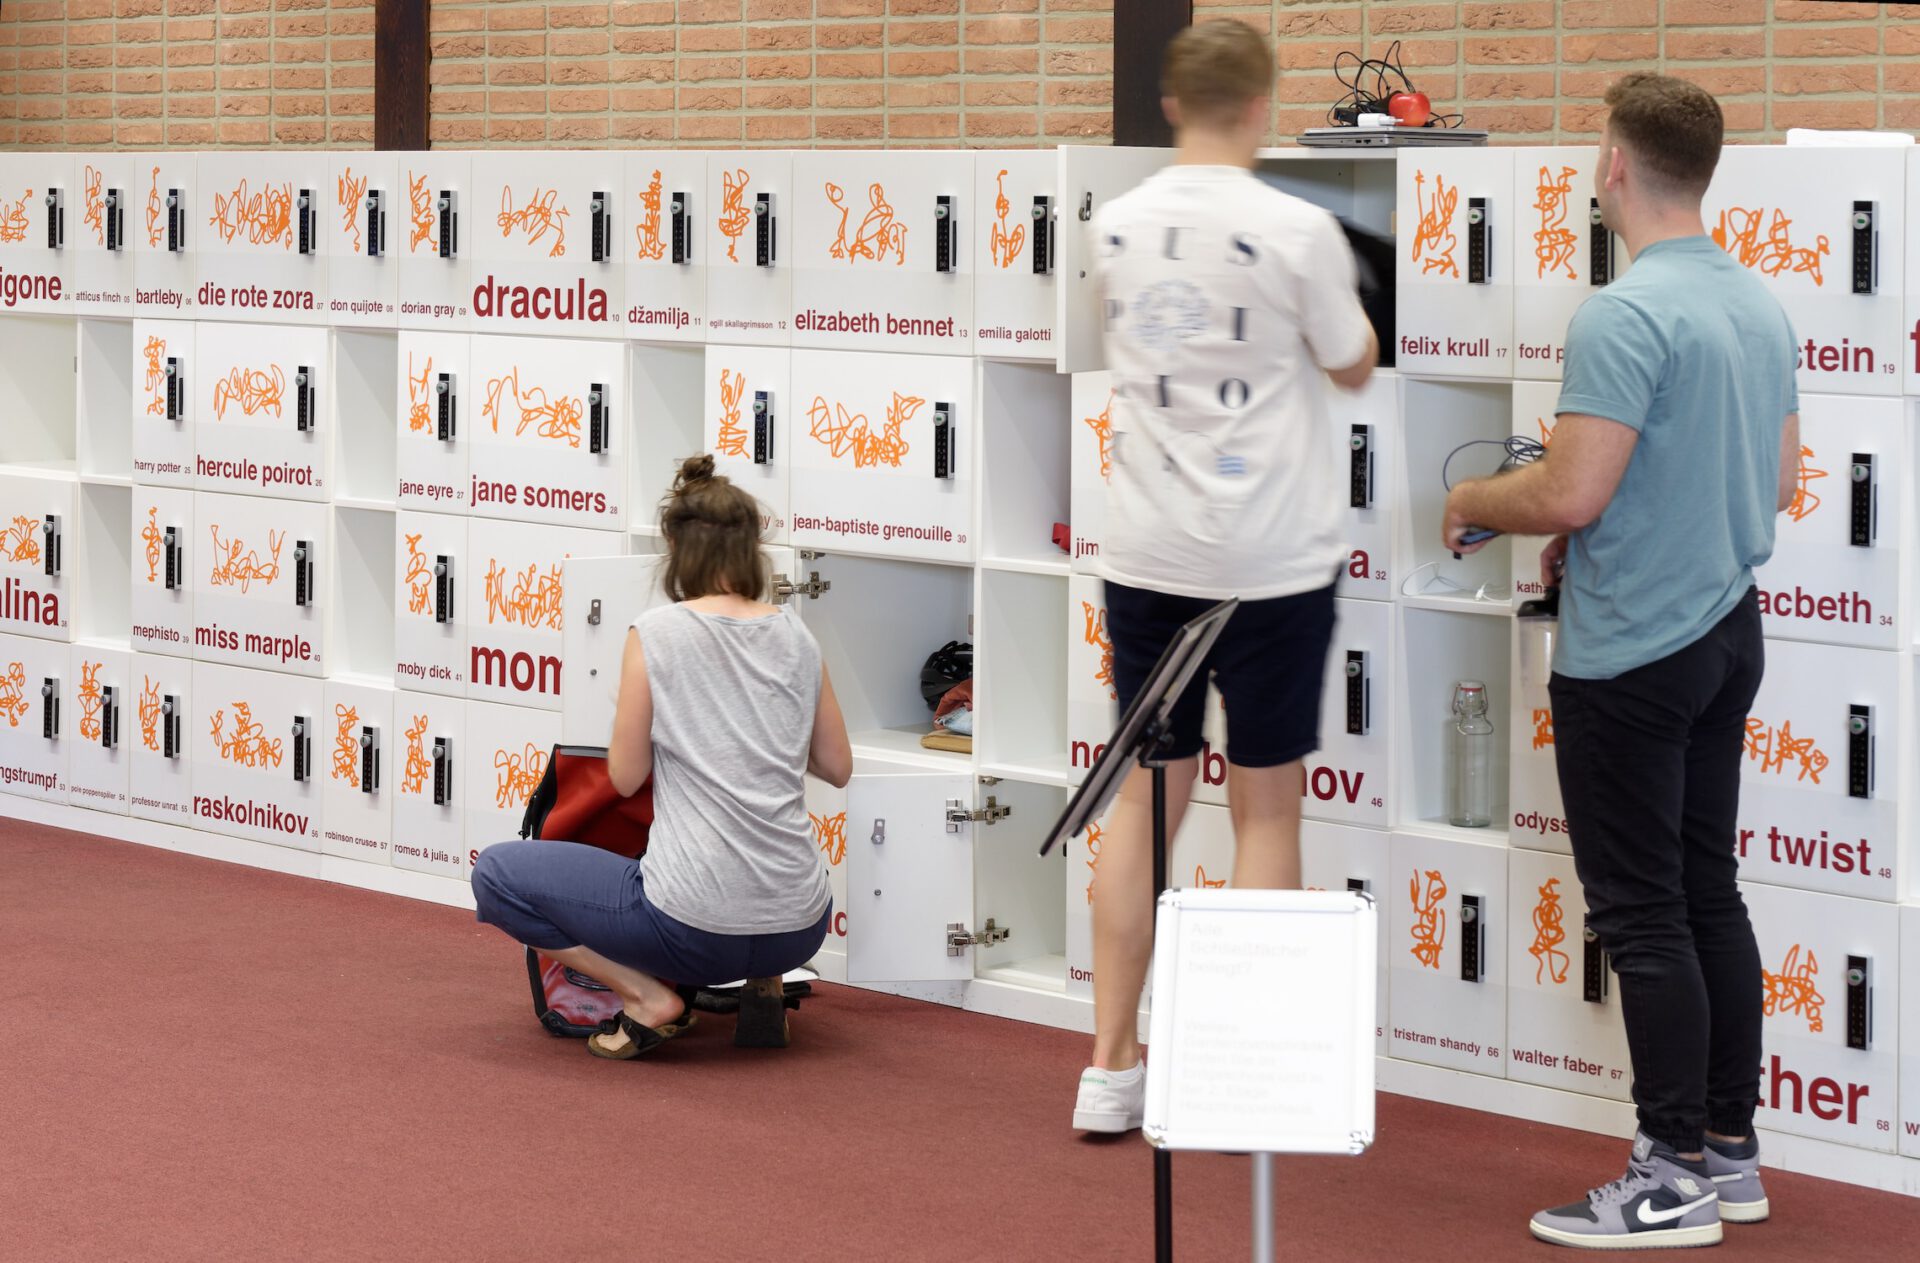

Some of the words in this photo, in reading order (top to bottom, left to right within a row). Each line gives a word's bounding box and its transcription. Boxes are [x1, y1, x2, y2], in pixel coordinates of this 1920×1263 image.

[76, 291, 100, 301] atticus
[103, 292, 121, 302] finch
[136, 288, 182, 309] bartleby
[198, 282, 225, 306] die
[232, 285, 267, 308] rote
[273, 290, 313, 309] zora
[317, 302, 324, 310] 07
[473, 275, 608, 321] dracula
[612, 314, 619, 322] 10
[331, 299, 348, 311] don
[351, 300, 383, 314] quijote
[401, 302, 431, 314] dorian
[434, 305, 455, 318] gray
[628, 306, 689, 329] džamilja
[779, 321, 786, 329] 12
[795, 310, 879, 333] elizabeth
[887, 313, 953, 337] bennet
[959, 329, 967, 337] 13
[979, 327, 1012, 339] emilia
[1016, 328, 1051, 342] galotti
[1401, 336, 1440, 355] felix
[1448, 337, 1488, 357] krull
[1496, 348, 1507, 357] 17
[1519, 344, 1550, 359] ford
[1883, 364, 1895, 374] 19
[135, 459, 155, 473] harry
[157, 463, 181, 474] potter
[197, 455, 257, 480] hercule
[263, 462, 312, 487] poirot
[399, 479, 424, 496] jane
[427, 485, 453, 500] eyre
[457, 491, 464, 499] 27
[471, 475, 517, 507] jane
[524, 486, 606, 513] somers
[610, 506, 617, 514] 28
[775, 519, 784, 528] 29
[793, 514, 879, 536] jean-baptiste
[883, 522, 952, 542] grenouille
[957, 534, 966, 543] 30
[1376, 570, 1386, 580] 32
[1880, 616, 1892, 626] 34
[133, 626, 179, 642] mephisto
[196, 624, 238, 650] miss
[246, 634, 310, 663] marple
[398, 663, 426, 679] moby
[429, 665, 451, 679] dick
[455, 673, 462, 681] 41
[132, 797, 160, 807] professor
[1371, 798, 1382, 807] 46
[193, 795, 309, 835] raskolnikov
[312, 830, 318, 838] 56
[325, 832, 353, 843] robinson
[355, 838, 377, 848] crusoe
[380, 842, 387, 850] 57
[395, 845, 420, 856] romeo
[423, 848, 428, 858] &
[431, 849, 448, 862] julia
[453, 856, 459, 864] 58
[1768, 826, 1871, 875] twist
[1878, 868, 1891, 878] 48
[1394, 1028, 1436, 1045] tristram
[1440, 1037, 1480, 1056] shandy
[1488, 1047, 1499, 1057] 66
[1513, 1049, 1559, 1067] walter
[1563, 1056, 1603, 1076] faber
[1611, 1069, 1623, 1079] 67
[1877, 1120, 1889, 1131] 68
